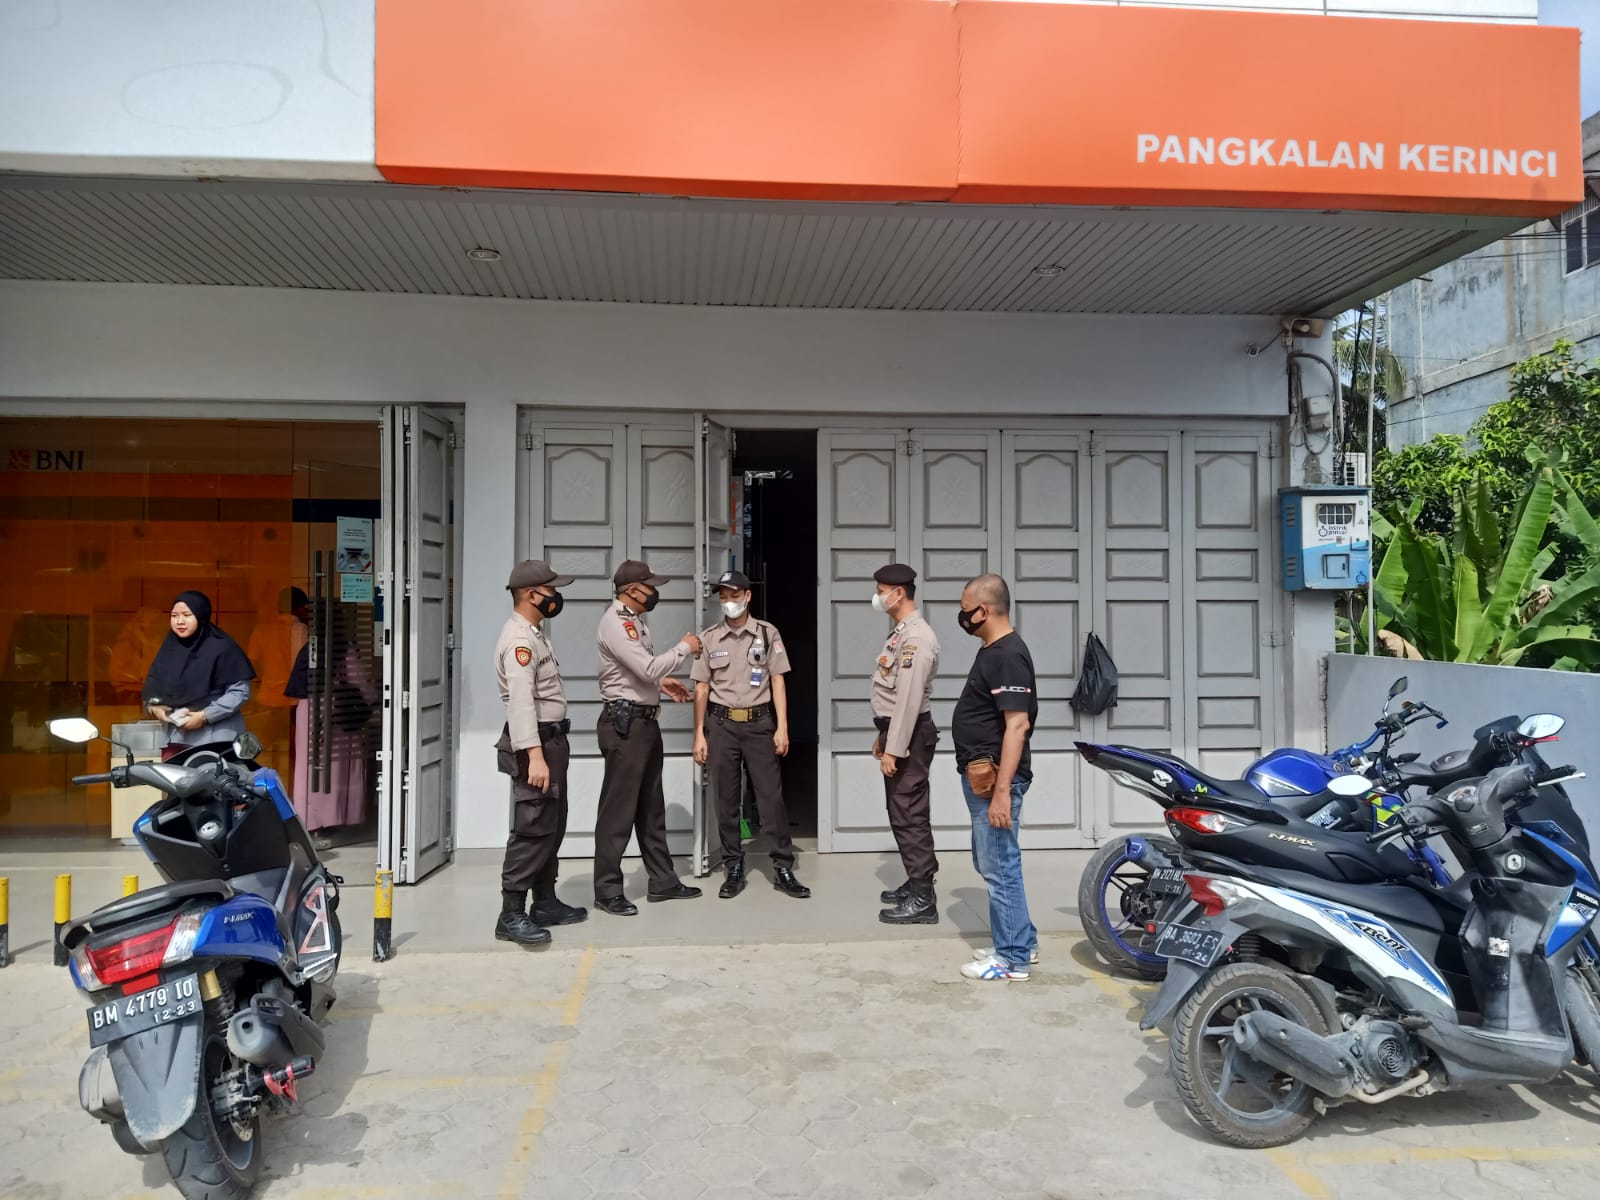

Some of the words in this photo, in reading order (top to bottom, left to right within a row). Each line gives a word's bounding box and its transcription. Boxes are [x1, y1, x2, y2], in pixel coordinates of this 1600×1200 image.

[1136, 133, 1385, 171] PANGKALAN
[1399, 143, 1558, 178] KERINCI
[36, 450, 84, 471] BNI
[1268, 833, 1316, 847] NMAX
[223, 910, 255, 924] NMAX
[1202, 935, 1219, 950] ES
[93, 1004, 119, 1029] BM
[125, 987, 168, 1017] 4779
